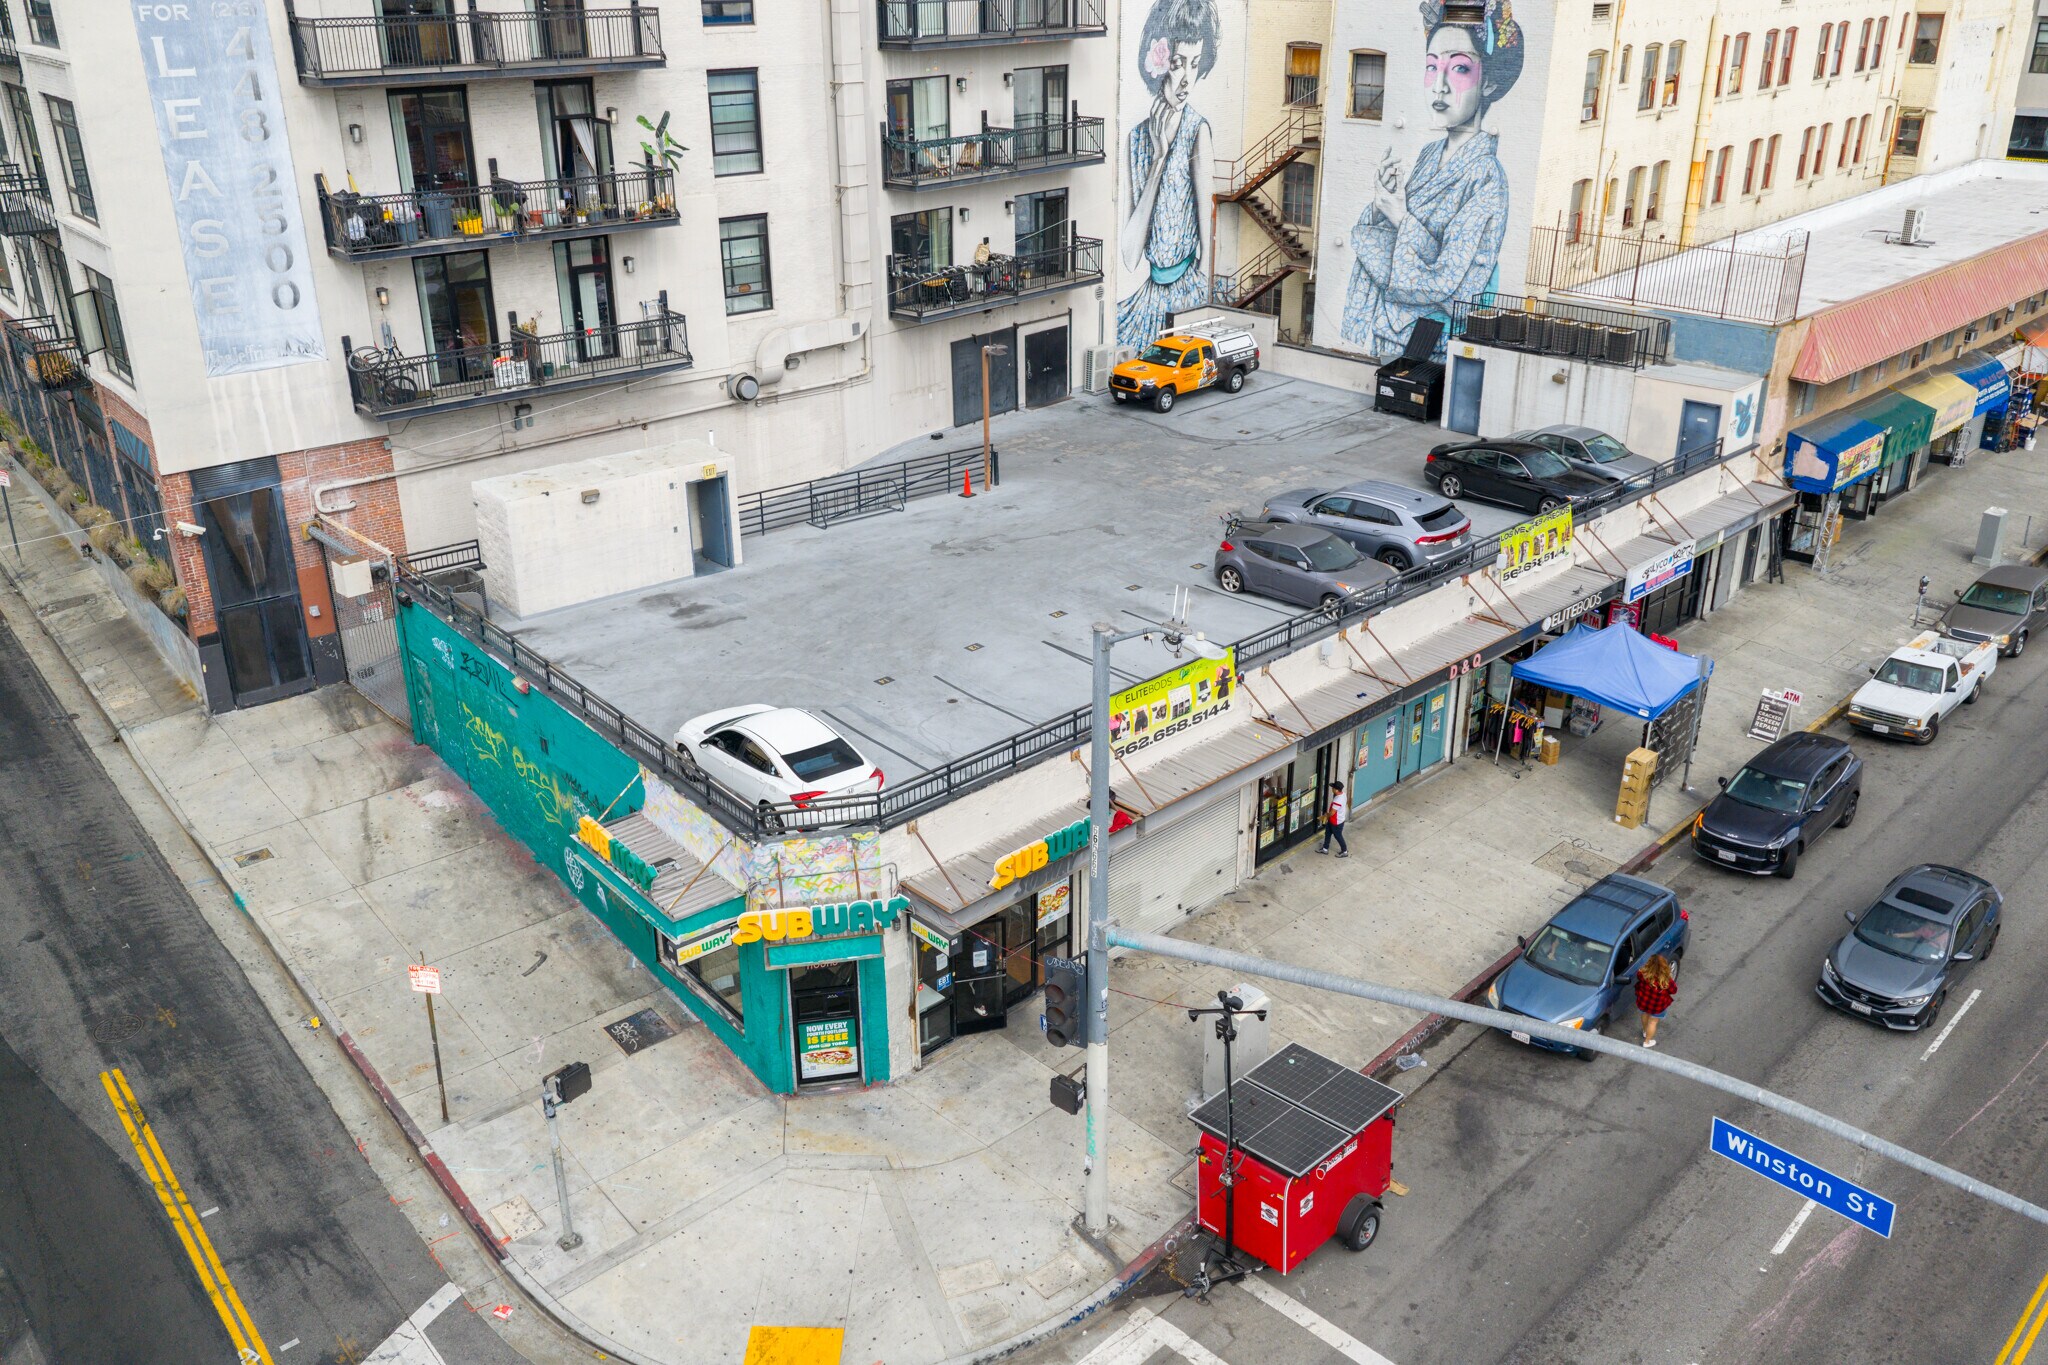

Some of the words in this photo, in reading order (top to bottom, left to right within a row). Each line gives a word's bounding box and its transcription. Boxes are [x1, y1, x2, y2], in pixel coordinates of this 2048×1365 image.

[138, 5, 190, 21] FOR
[151, 36, 242, 315] LEASE
[1500, 531, 1514, 542] LOS
[1551, 591, 1602, 628] ELITEBODS
[1582, 612, 1600, 629] ATM
[1450, 665, 1458, 680] D
[1461, 659, 1470, 674] &
[1473, 653, 1481, 668] Q
[1125, 677, 1173, 704] ELITEBODS
[1783, 691, 1800, 704] ATM
[1758, 711, 1782, 721] CRACKED
[1761, 703, 1769, 711] 15
[1114, 699, 1231, 760] 562.658.5144
[1754, 721, 1778, 732] REPAIR
[1756, 716, 1780, 727] SCREEN
[578, 814, 659, 891] SUBWAY
[989, 815, 1090, 890] SUBWA
[731, 894, 910, 947] SUBWAY
[679, 932, 730, 962] SUBWAY
[912, 922, 948, 950] SUBWAY
[938, 974, 950, 985] EBT
[806, 1024, 823, 1032] NOW
[825, 1021, 847, 1030] EVERY
[807, 1036, 819, 1045] IS
[820, 1032, 848, 1043] FREE
[1727, 1131, 1832, 1199] Winston
[1846, 1192, 1878, 1220] St
